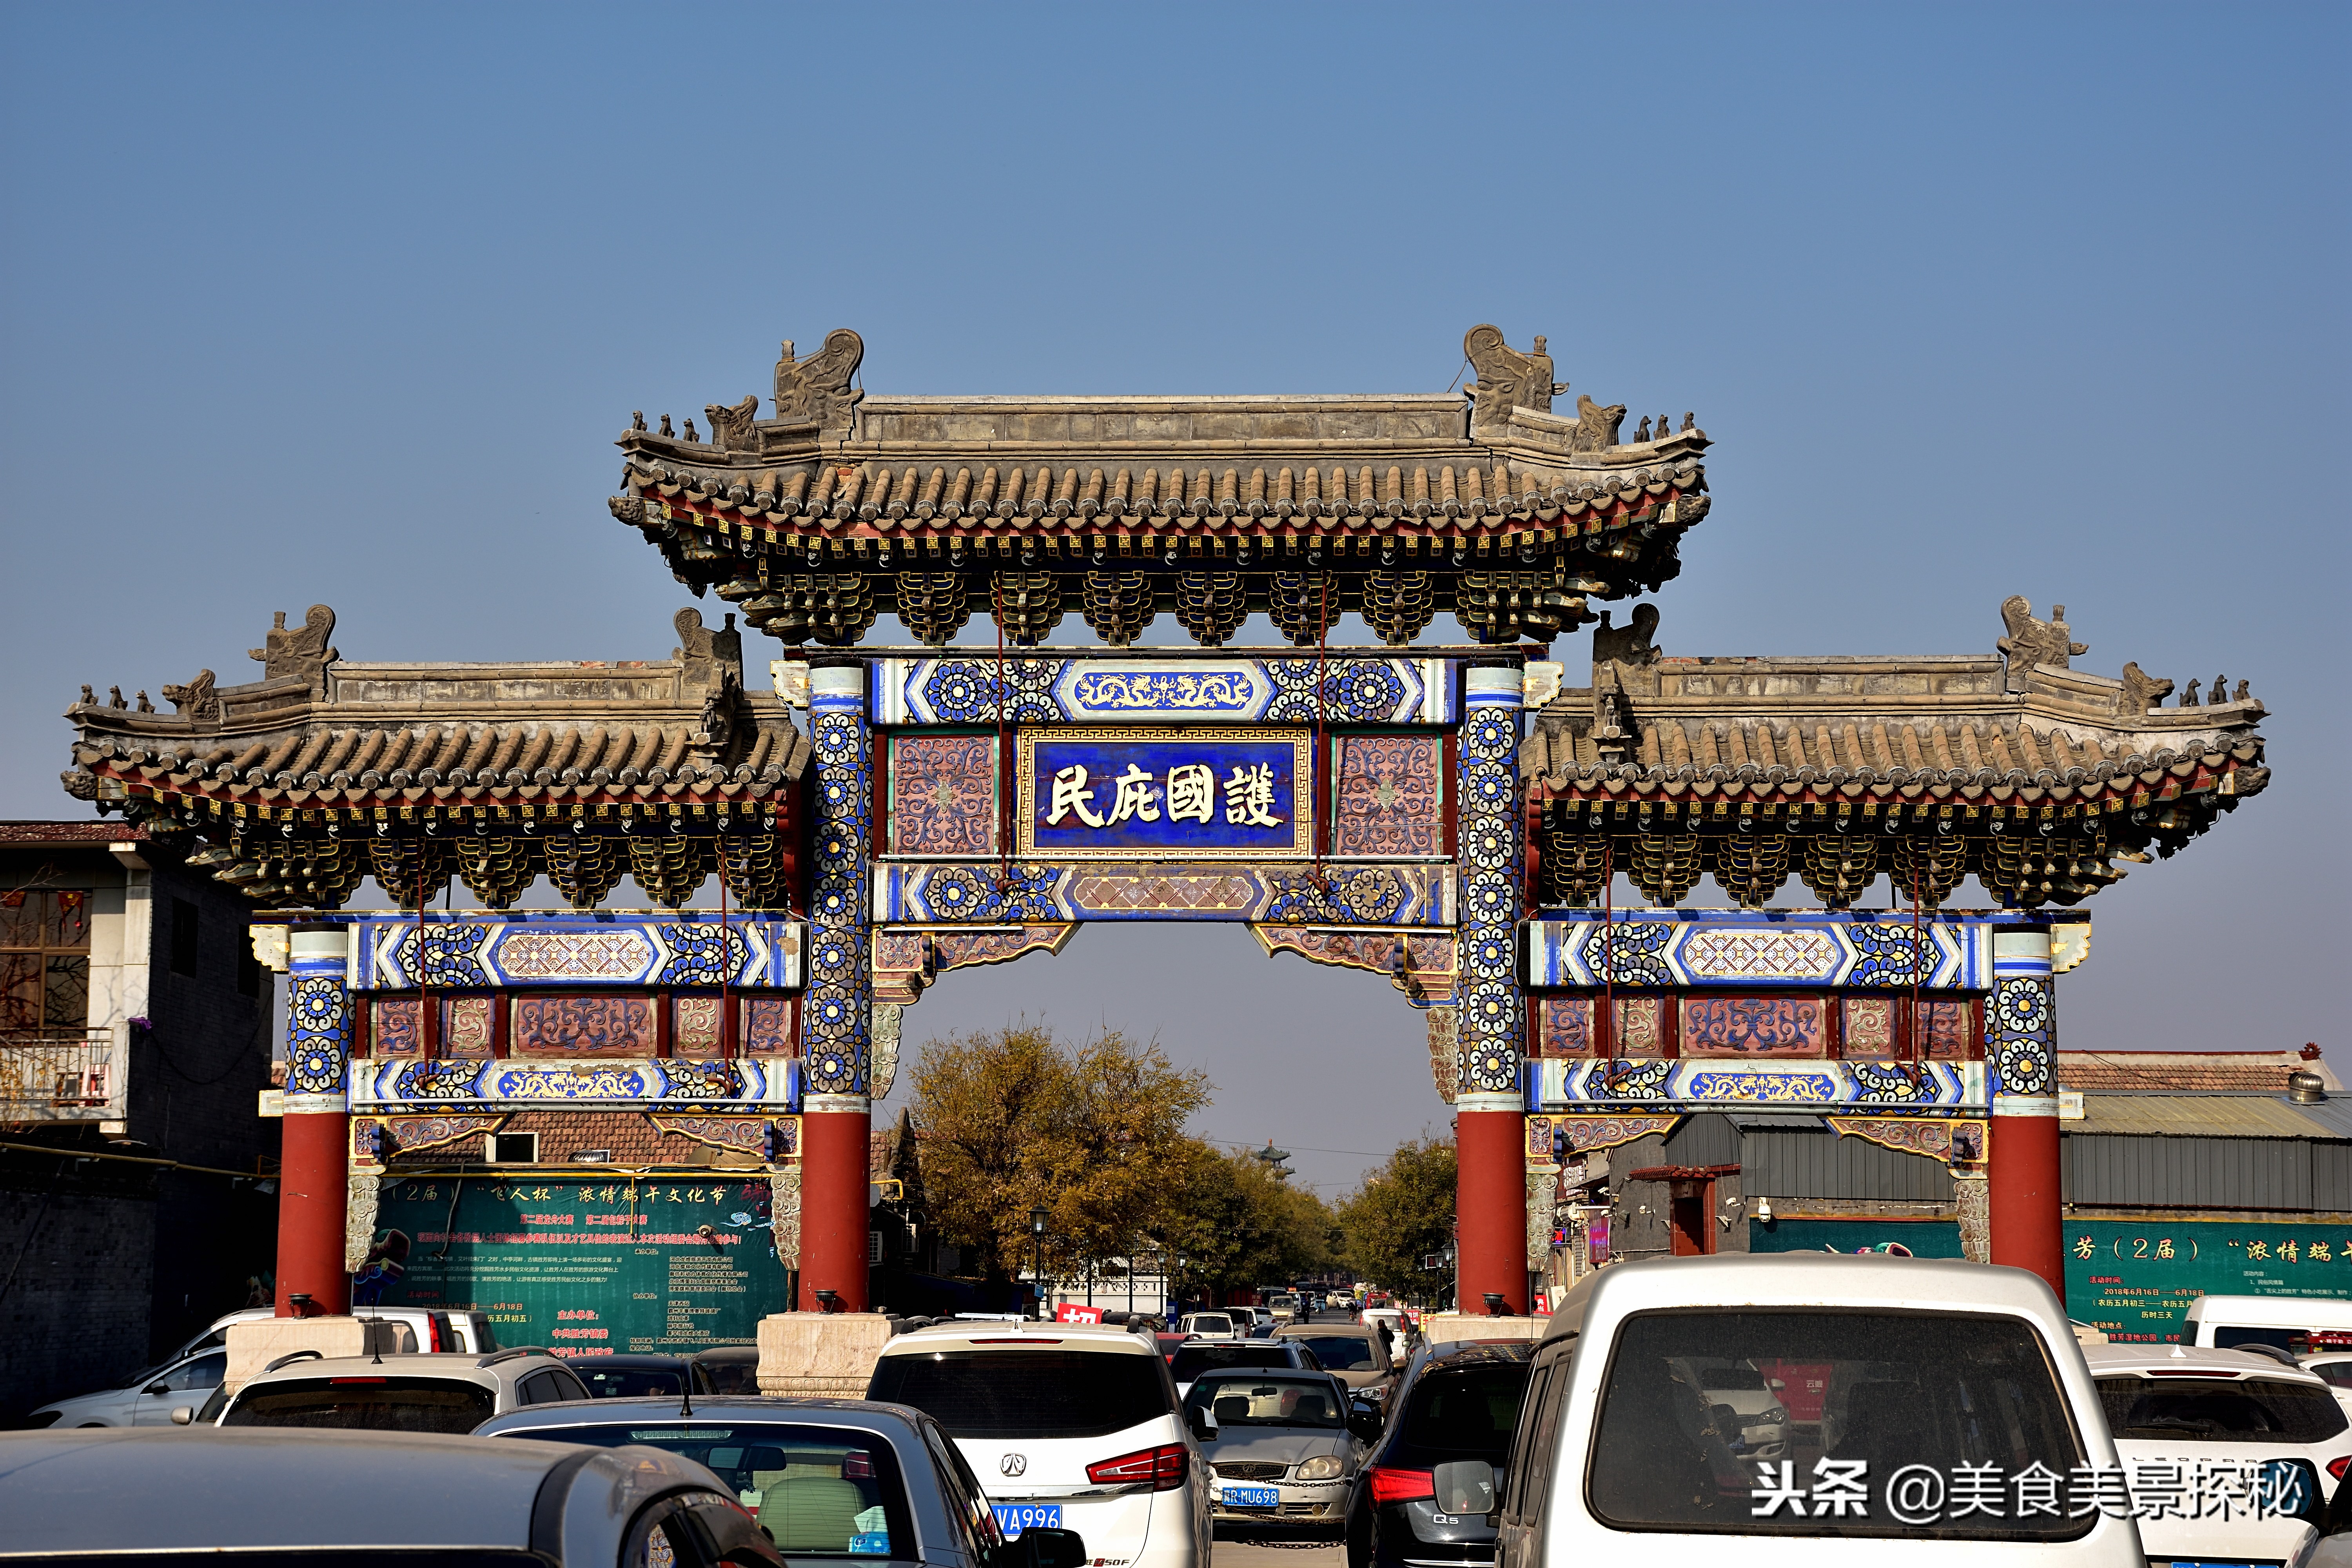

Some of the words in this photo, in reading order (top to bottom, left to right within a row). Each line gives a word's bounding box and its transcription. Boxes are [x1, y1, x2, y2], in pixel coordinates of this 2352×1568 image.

[520, 1214, 574, 1225] 第二届龙舟大赛
[557, 1310, 599, 1320] 主办单位：
[552, 1328, 608, 1339] 中共胜芳镇委
[548, 1347, 613, 1358] 胜芳镇人民政府
[1433, 1514, 1459, 1524] Q5
